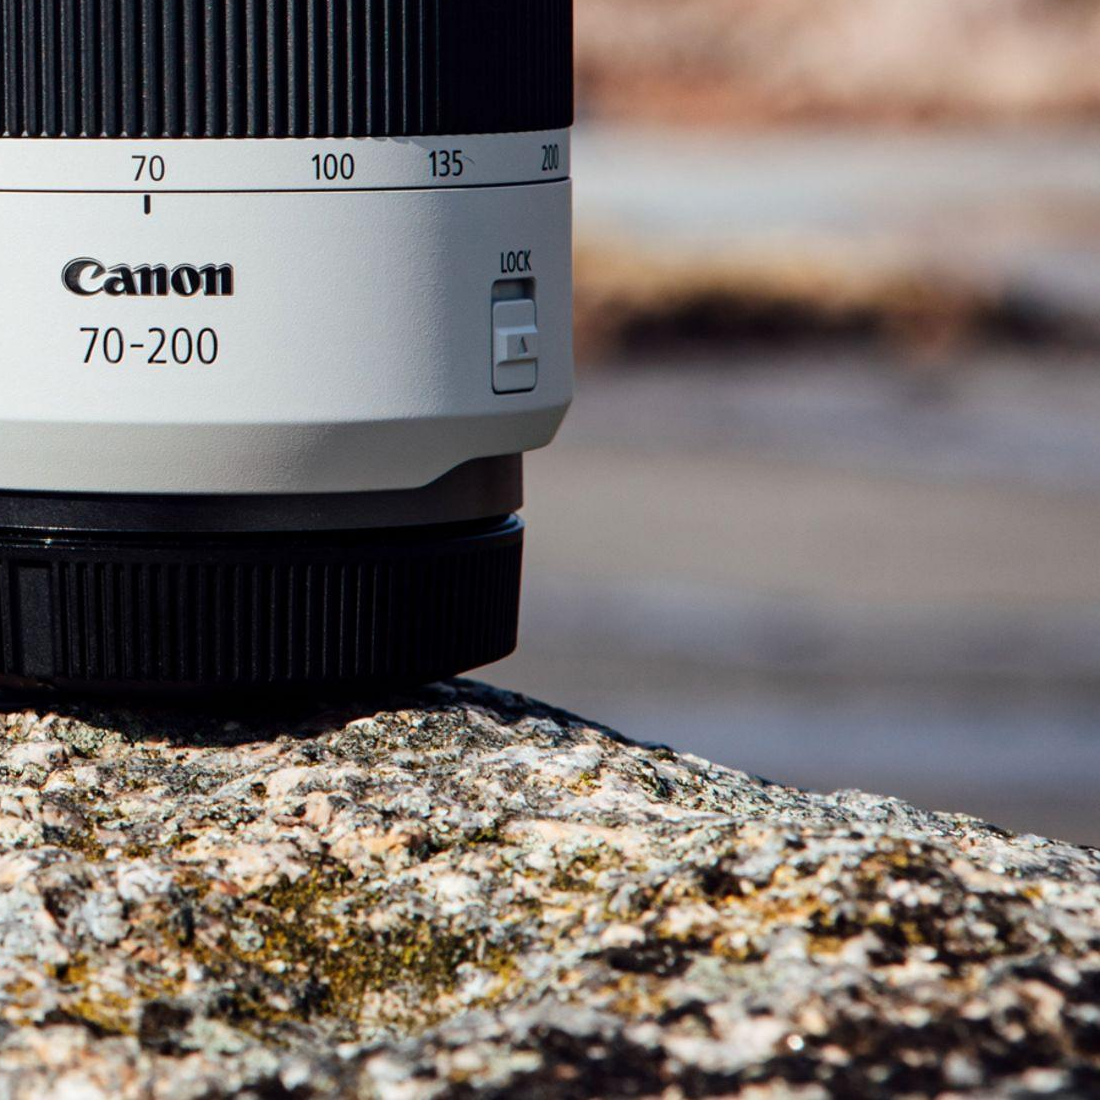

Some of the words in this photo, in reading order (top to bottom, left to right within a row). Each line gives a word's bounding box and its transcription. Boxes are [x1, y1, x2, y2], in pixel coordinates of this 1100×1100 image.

[131, 155, 165, 182] 70
[311, 153, 355, 180] 100
[428, 150, 463, 177] 135
[541, 144, 559, 171] 200
[61, 256, 235, 297] Canon
[500, 250, 532, 273] LOCK
[80, 327, 219, 364] 70-200
